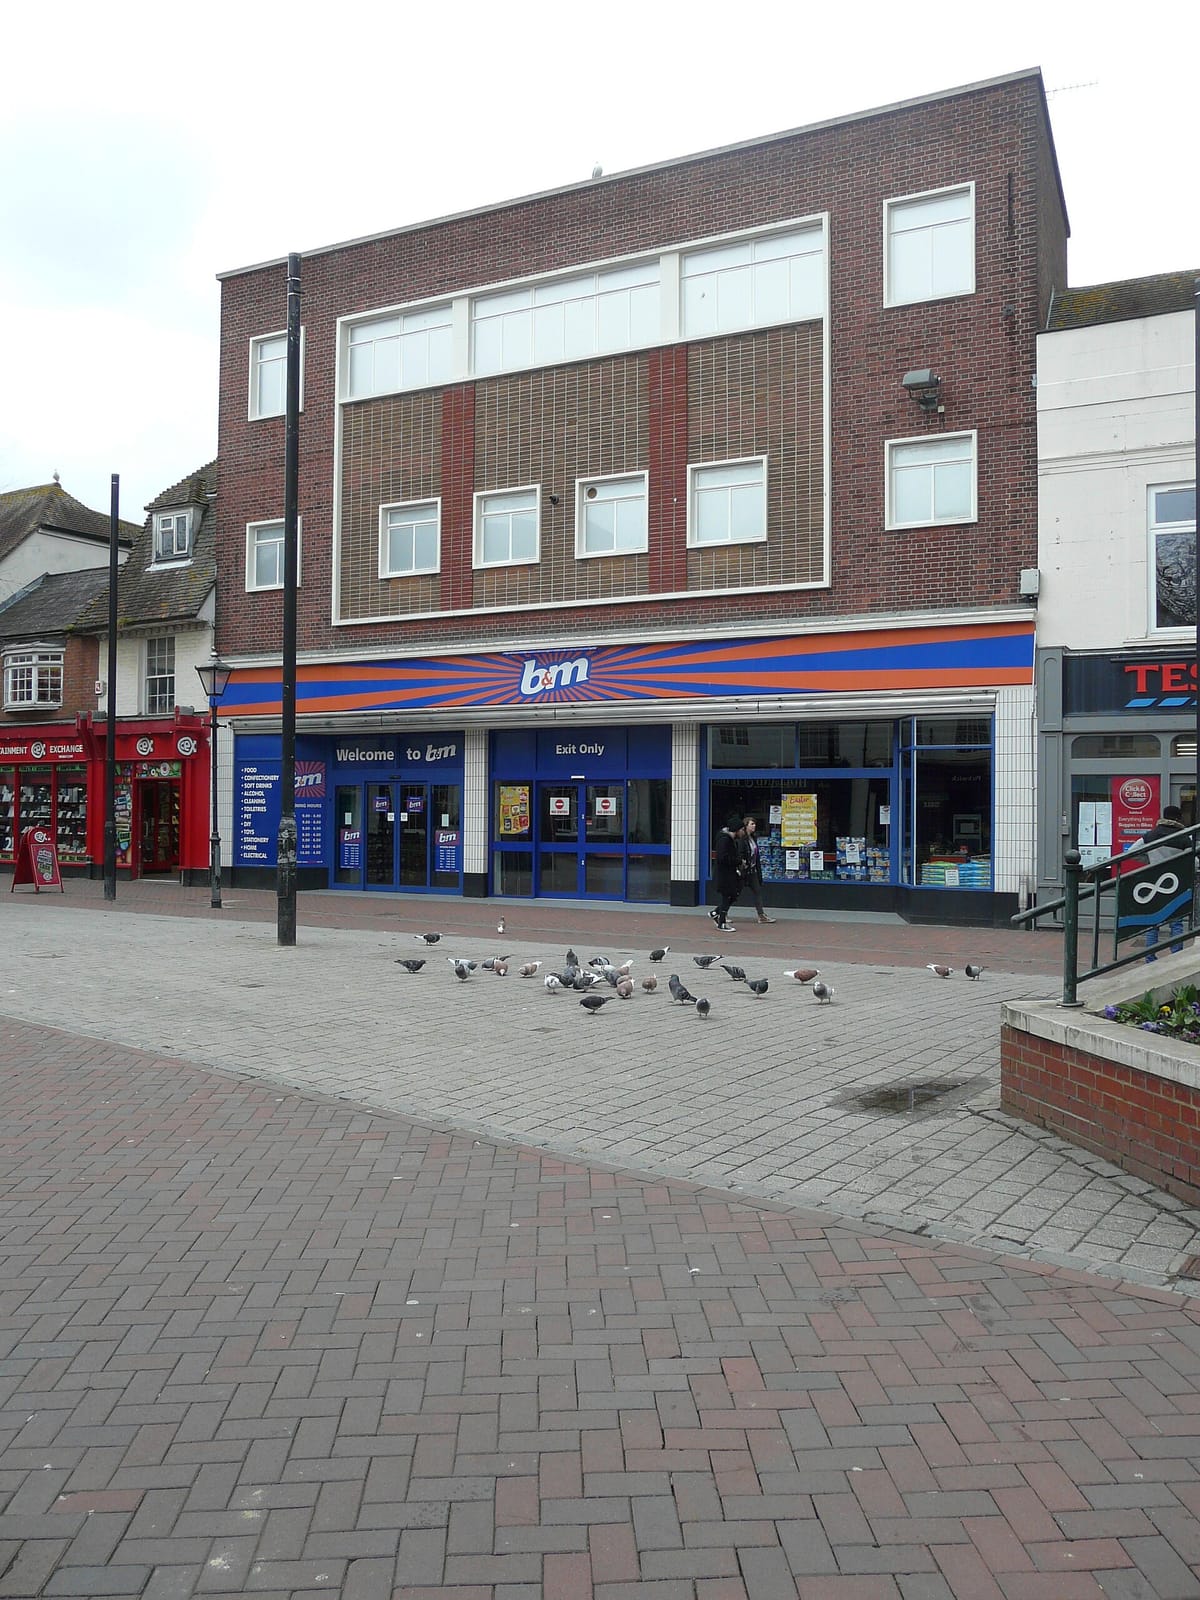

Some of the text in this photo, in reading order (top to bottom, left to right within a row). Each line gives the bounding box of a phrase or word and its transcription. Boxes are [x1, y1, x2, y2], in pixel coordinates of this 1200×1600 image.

[521, 658, 589, 695] b&m
[0, 746, 28, 755] AINMENT
[49, 744, 84, 754] EXCHANGE
[336, 747, 395, 761] Welcome
[406, 748, 421, 760] to
[555, 743, 605, 756] Exit Only
